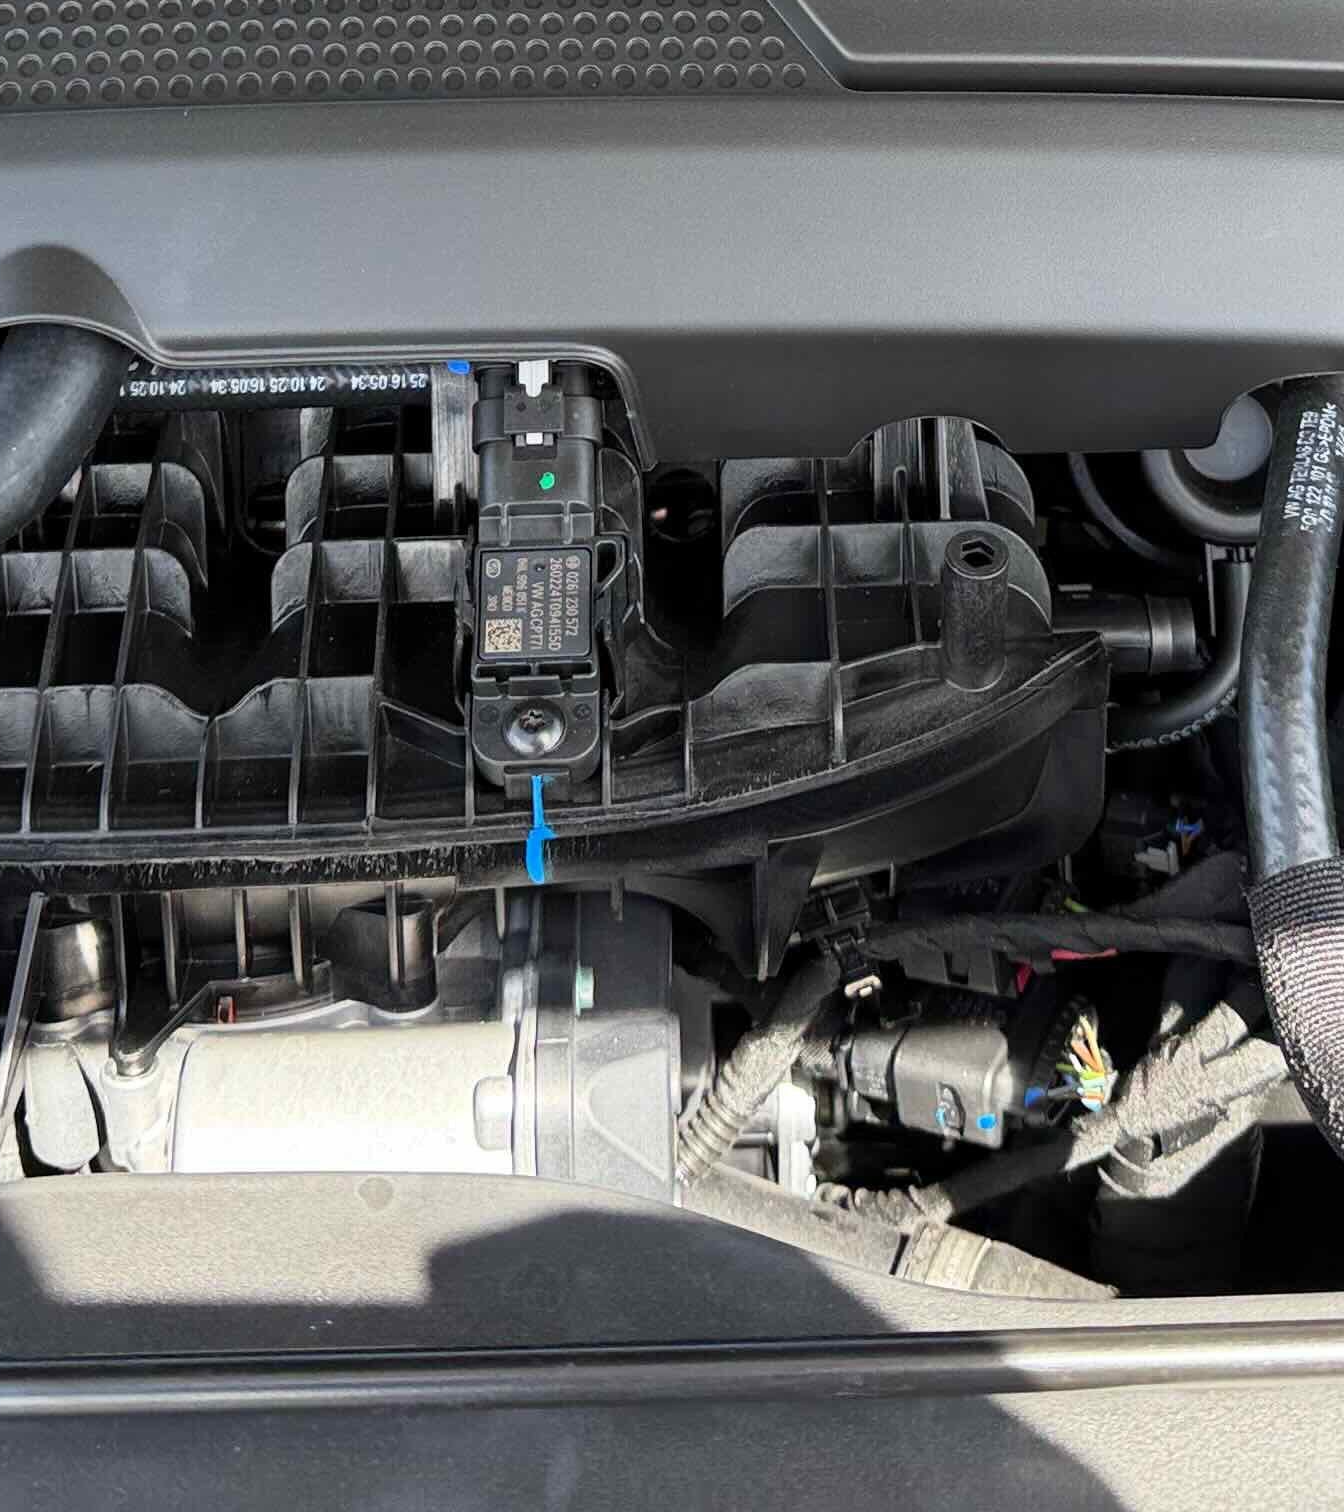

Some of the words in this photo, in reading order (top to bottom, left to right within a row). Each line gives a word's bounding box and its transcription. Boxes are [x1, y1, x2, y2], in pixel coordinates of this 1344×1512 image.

[1309, 464, 1328, 482] 101
[1305, 485, 1324, 505] 122
[531, 581, 545, 600] VW
[565, 571, 580, 594] 0261
[529, 600, 545, 618] AG
[565, 597, 580, 617] 230
[565, 617, 580, 637] 572
